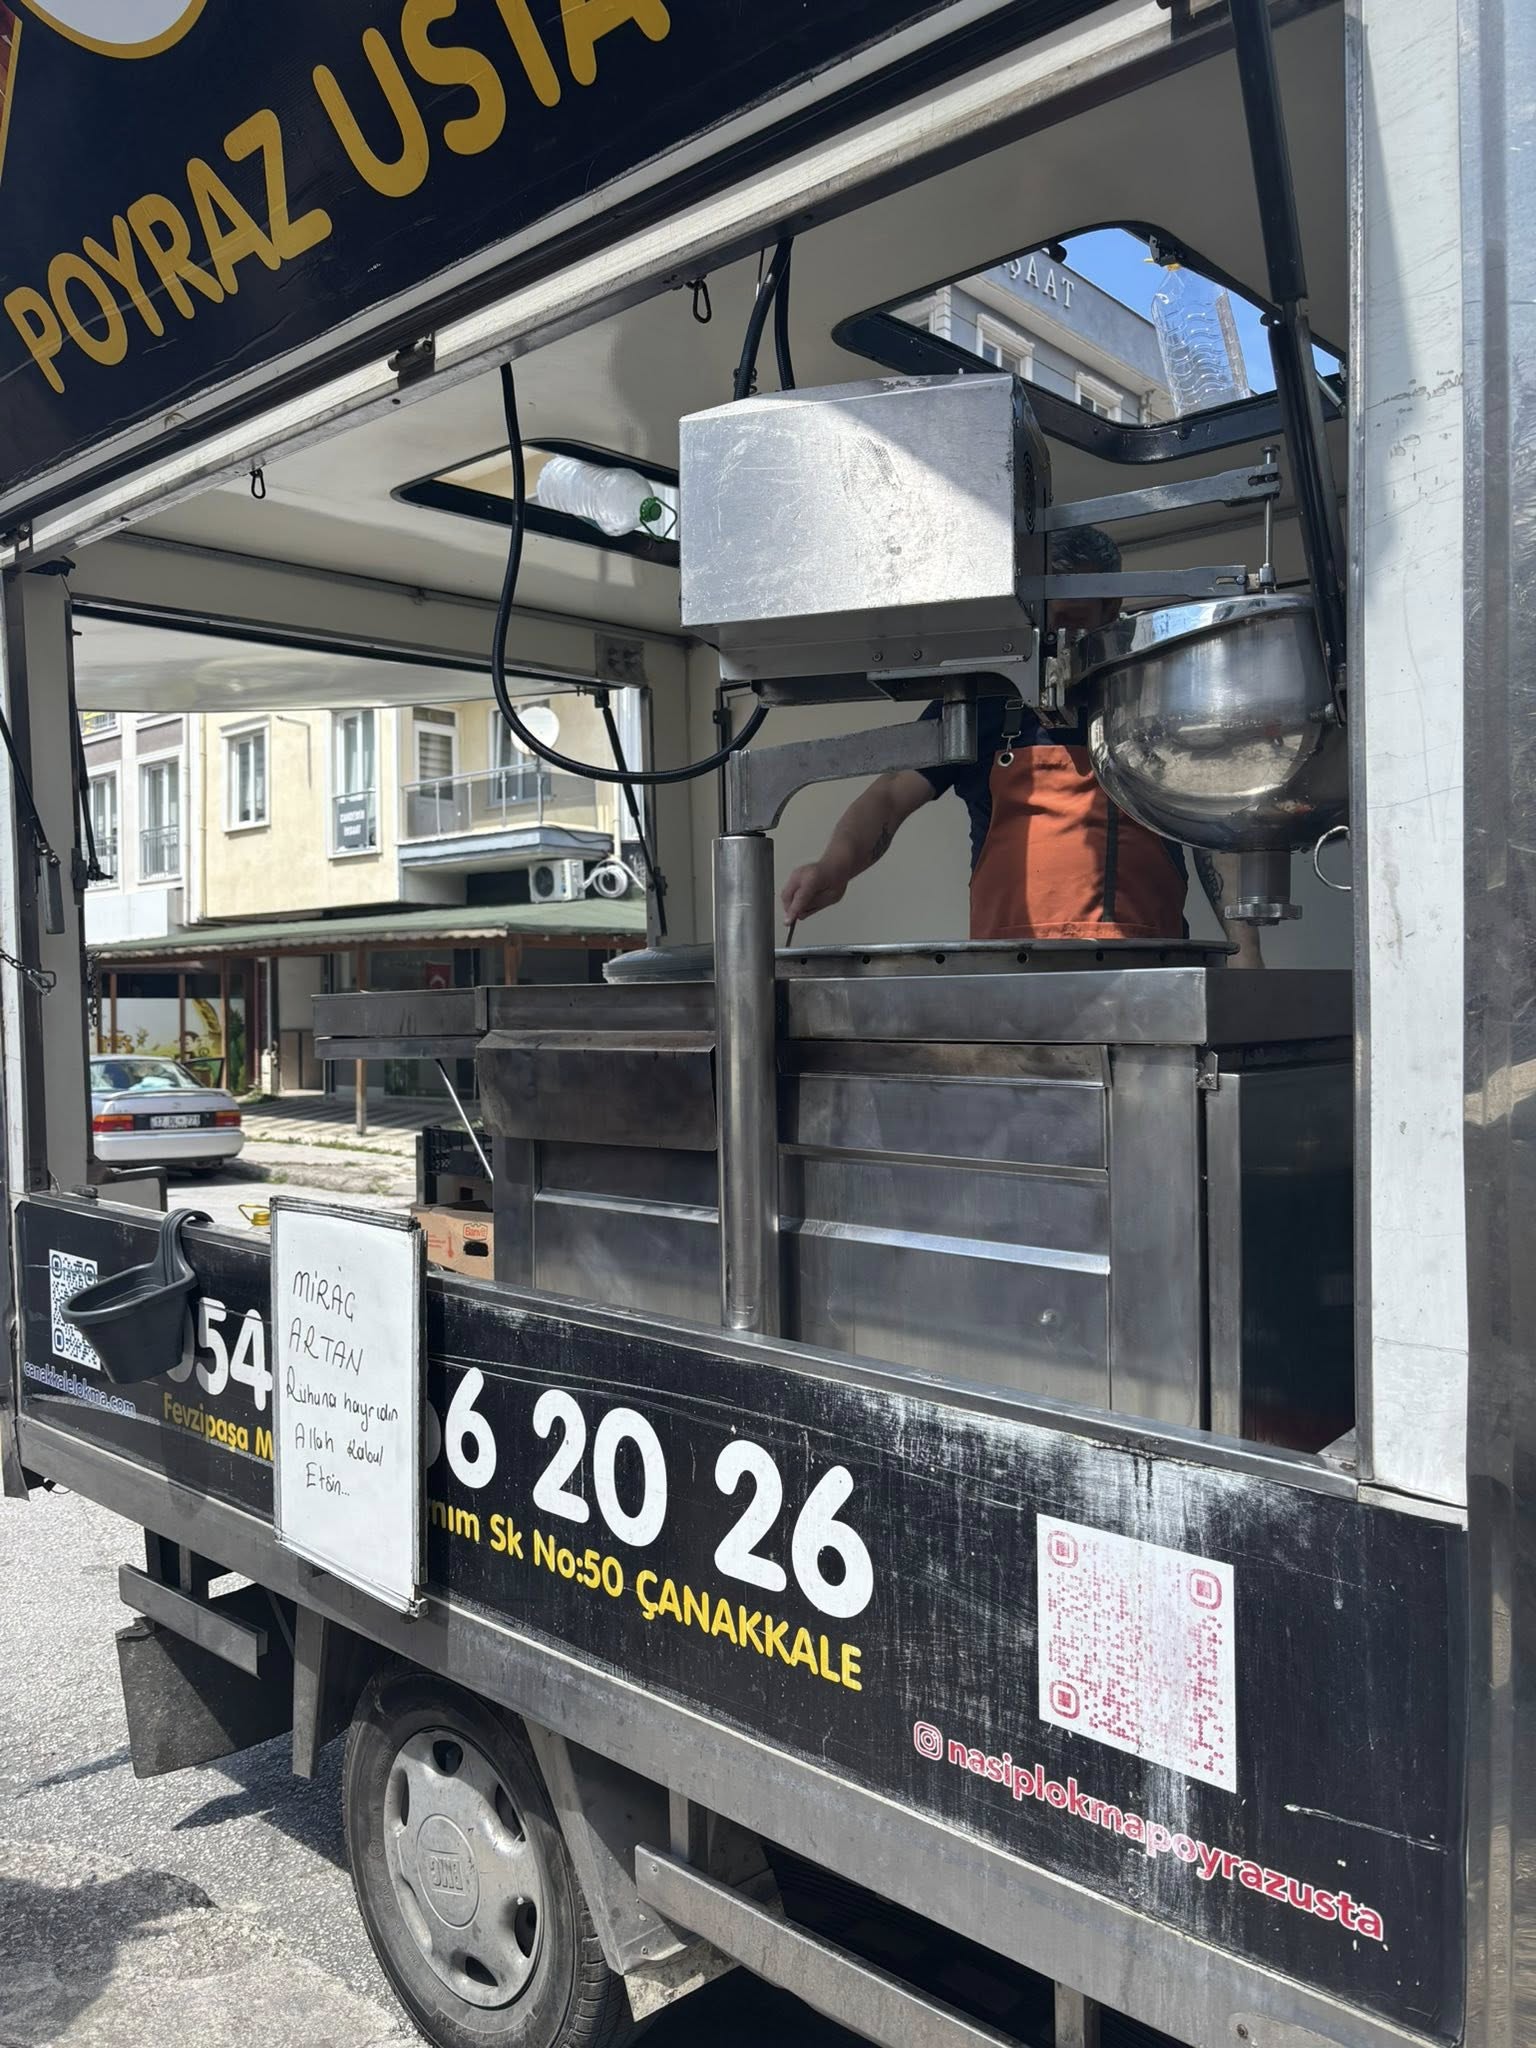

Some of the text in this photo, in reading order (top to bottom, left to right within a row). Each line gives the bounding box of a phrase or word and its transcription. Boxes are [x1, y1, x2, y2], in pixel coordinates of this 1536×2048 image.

[3, 108, 333, 394] POYRAZ
[1002, 255, 1075, 308] ŞAAT
[23, 1360, 138, 1420] canakkalelokma.com
[288, 1316, 364, 1376] ARTAN
[163, 1391, 249, 1454] Fevzipaşa
[428, 1499, 481, 1544] nım
[489, 1513, 524, 1560] Sk
[533, 1528, 625, 1598] No:50
[636, 1569, 863, 1692] ÇANAKKALE
[427, 1366, 497, 1489] 6
[533, 1389, 667, 1547] 20
[714, 1439, 874, 1619] 26
[947, 1738, 1386, 1943] nasiplokmapoyrazusta
